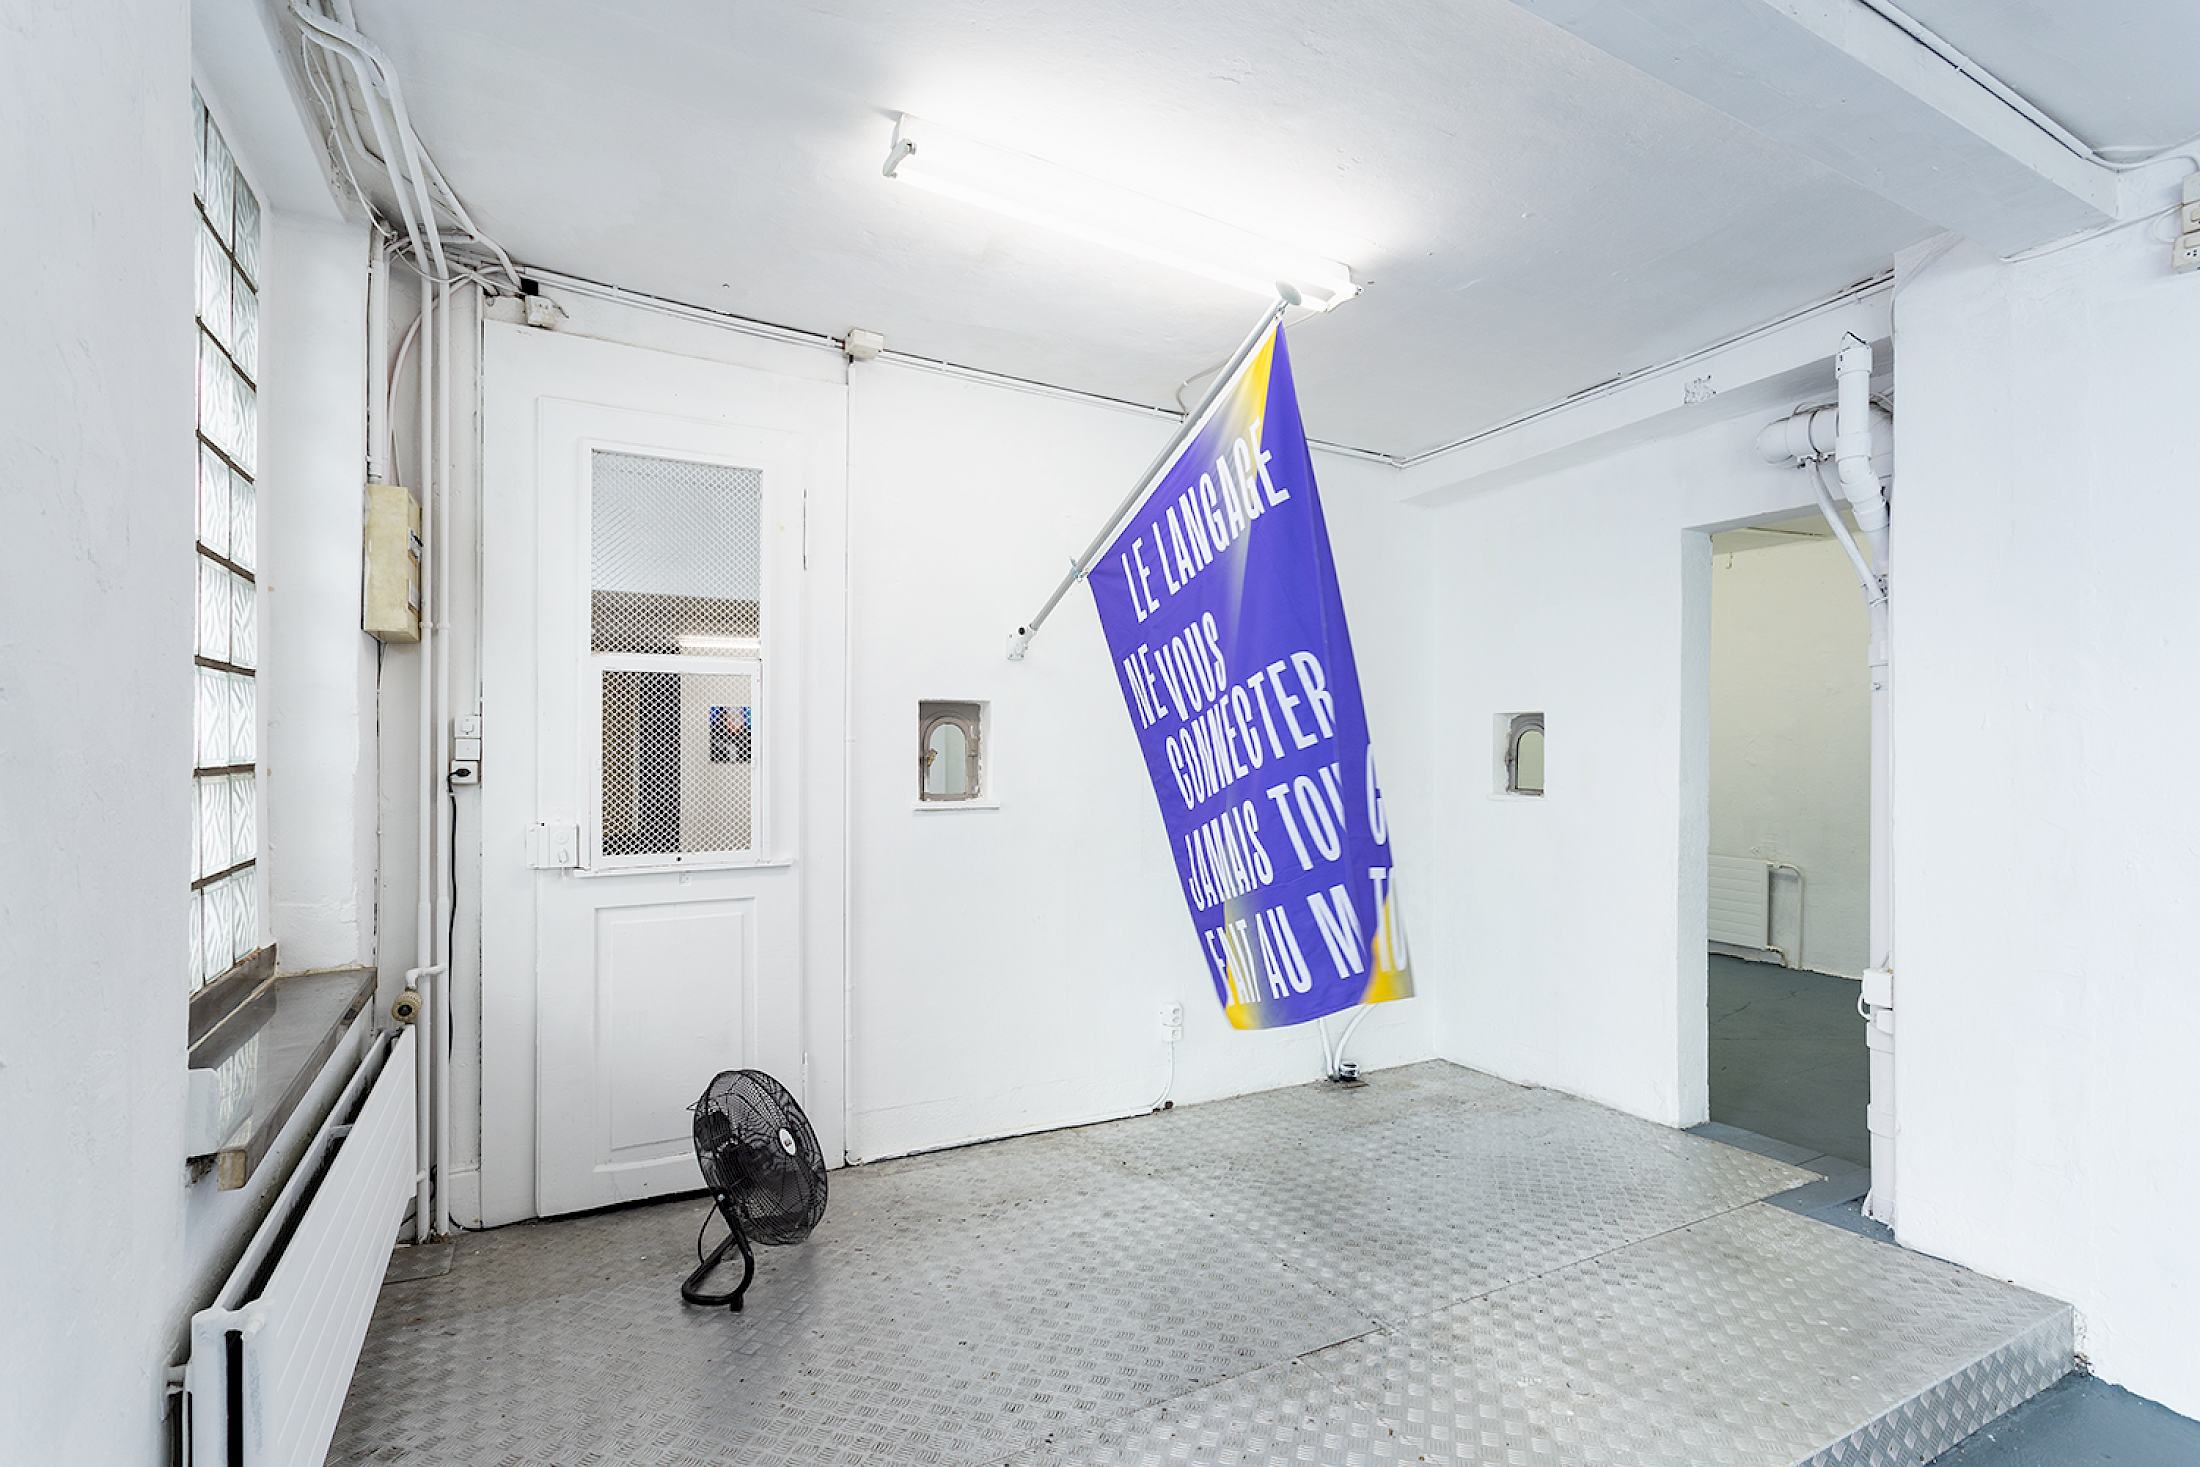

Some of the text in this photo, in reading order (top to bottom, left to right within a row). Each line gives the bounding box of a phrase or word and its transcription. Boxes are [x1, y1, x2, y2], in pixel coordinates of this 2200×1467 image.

[1121, 416, 1291, 623] LE LANGAGE
[1123, 611, 1226, 730] NE VOUS
[1166, 651, 1336, 811] CONNECTER
[1184, 800, 1274, 911] JAMAIS
[1255, 904, 1312, 1000] AU
